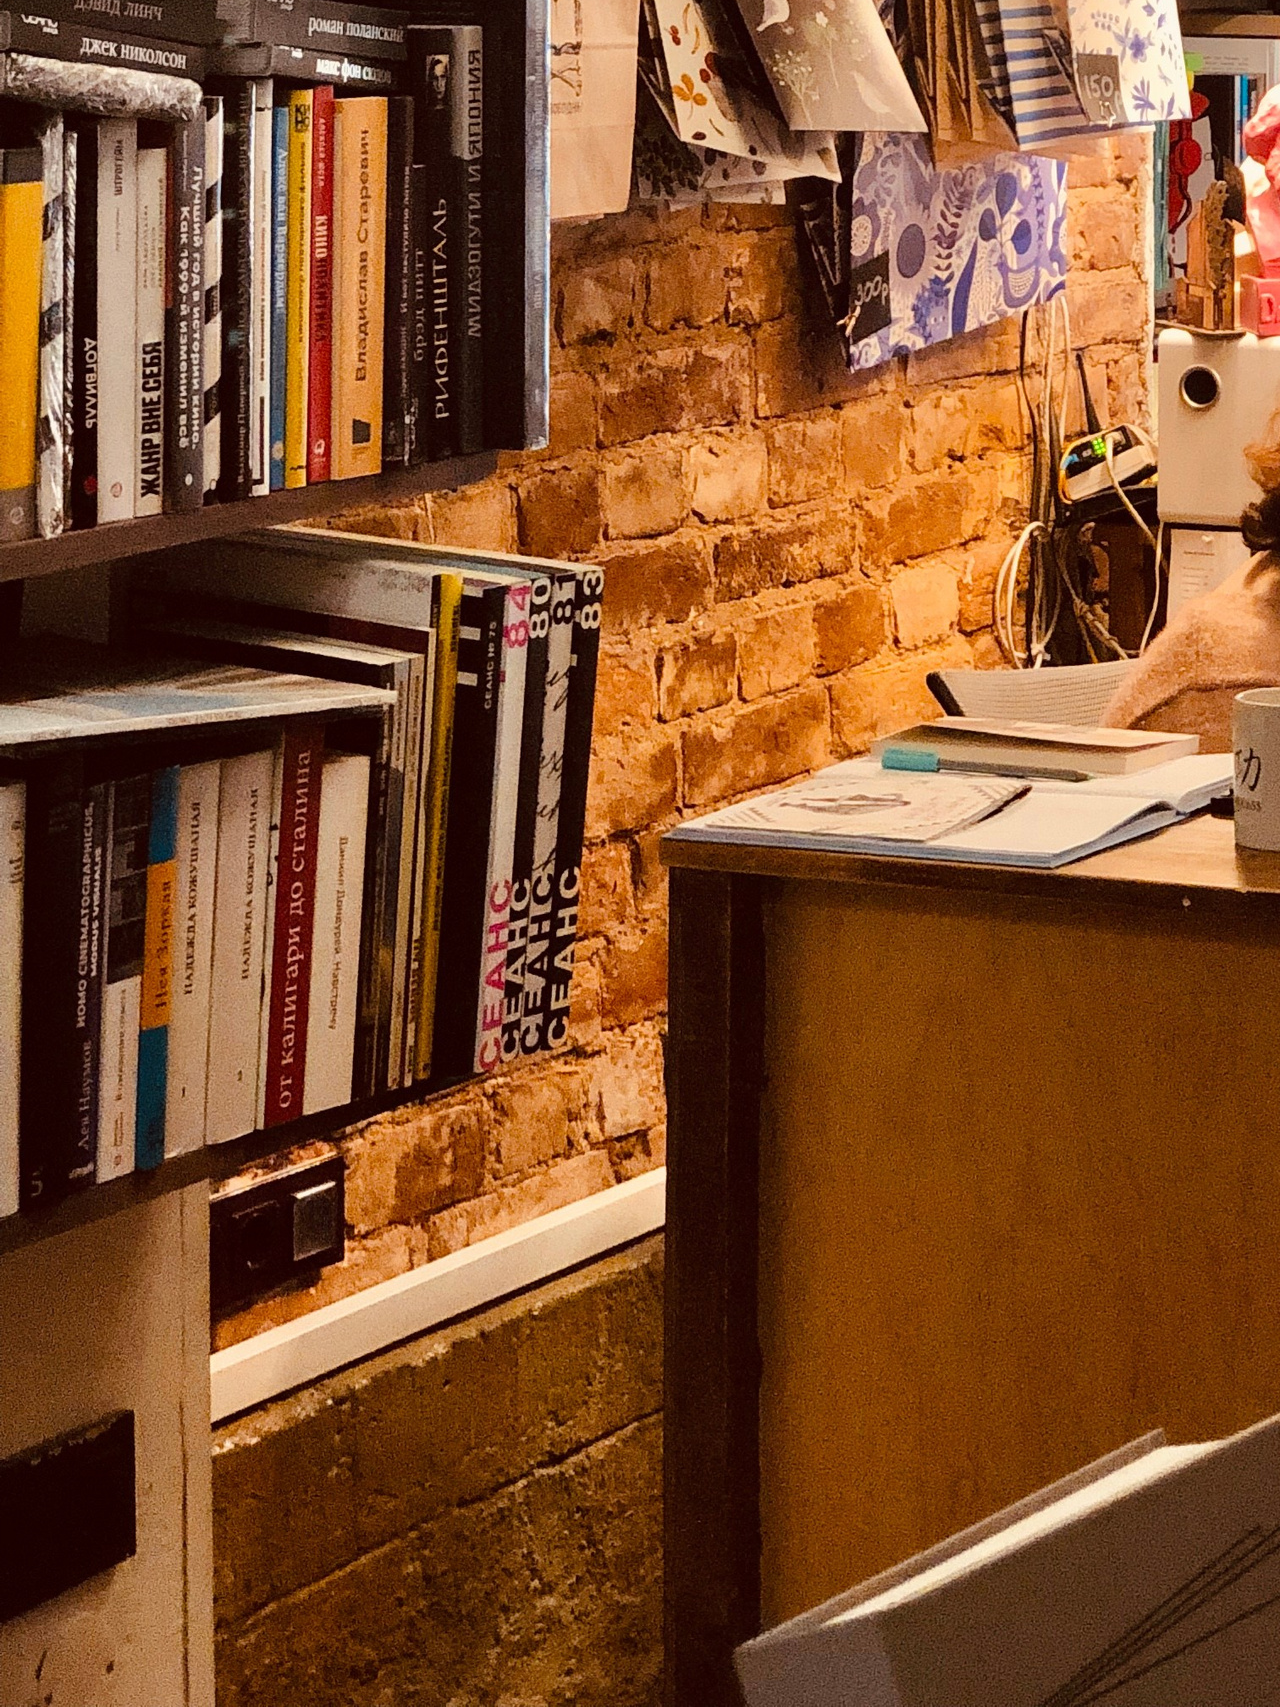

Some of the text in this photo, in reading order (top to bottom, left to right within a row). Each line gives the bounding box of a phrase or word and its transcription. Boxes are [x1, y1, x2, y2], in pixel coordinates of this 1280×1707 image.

[307, 16, 404, 43] роман поланский
[316, 57, 362, 83] макс фон
[274, 147, 288, 307] Алекс ван Вармердам
[466, 49, 483, 338] МИДЗОГУТИ И ЯПОНИЯ
[178, 205, 191, 450] Как 1999-й изменил всё
[189, 165, 204, 451] Лучший год в истории кино.
[355, 248, 370, 383] Владислав
[412, 248, 428, 363] брэд питт
[431, 198, 450, 420] РИФЕНШТАЛЬ
[85, 337, 98, 429] ДОГВИЛЛЬ
[140, 341, 163, 499] ЖАНР ВНЕ СЕБЯ
[506, 585, 531, 648] 84
[529, 576, 552, 639] 80
[553, 573, 576, 625] 81
[580, 569, 605, 630] 83
[484, 661, 495, 710] СЕАНС
[290, 748, 311, 873] сталина
[90, 919, 100, 977] MODUS
[183, 801, 202, 996] НАДЕЖДА КОЖУШАНАЯ
[240, 787, 259, 981] НАДЕЖДА КОЖУШАНАЯ
[287, 880, 305, 916] до
[76, 978, 88, 1029] HOMO
[279, 924, 304, 1065] калигари
[478, 879, 513, 1073] СЕАНС
[501, 878, 531, 1063] СЕАНС
[520, 872, 553, 1056] СЕАНС
[547, 865, 581, 1050] СЕАНС
